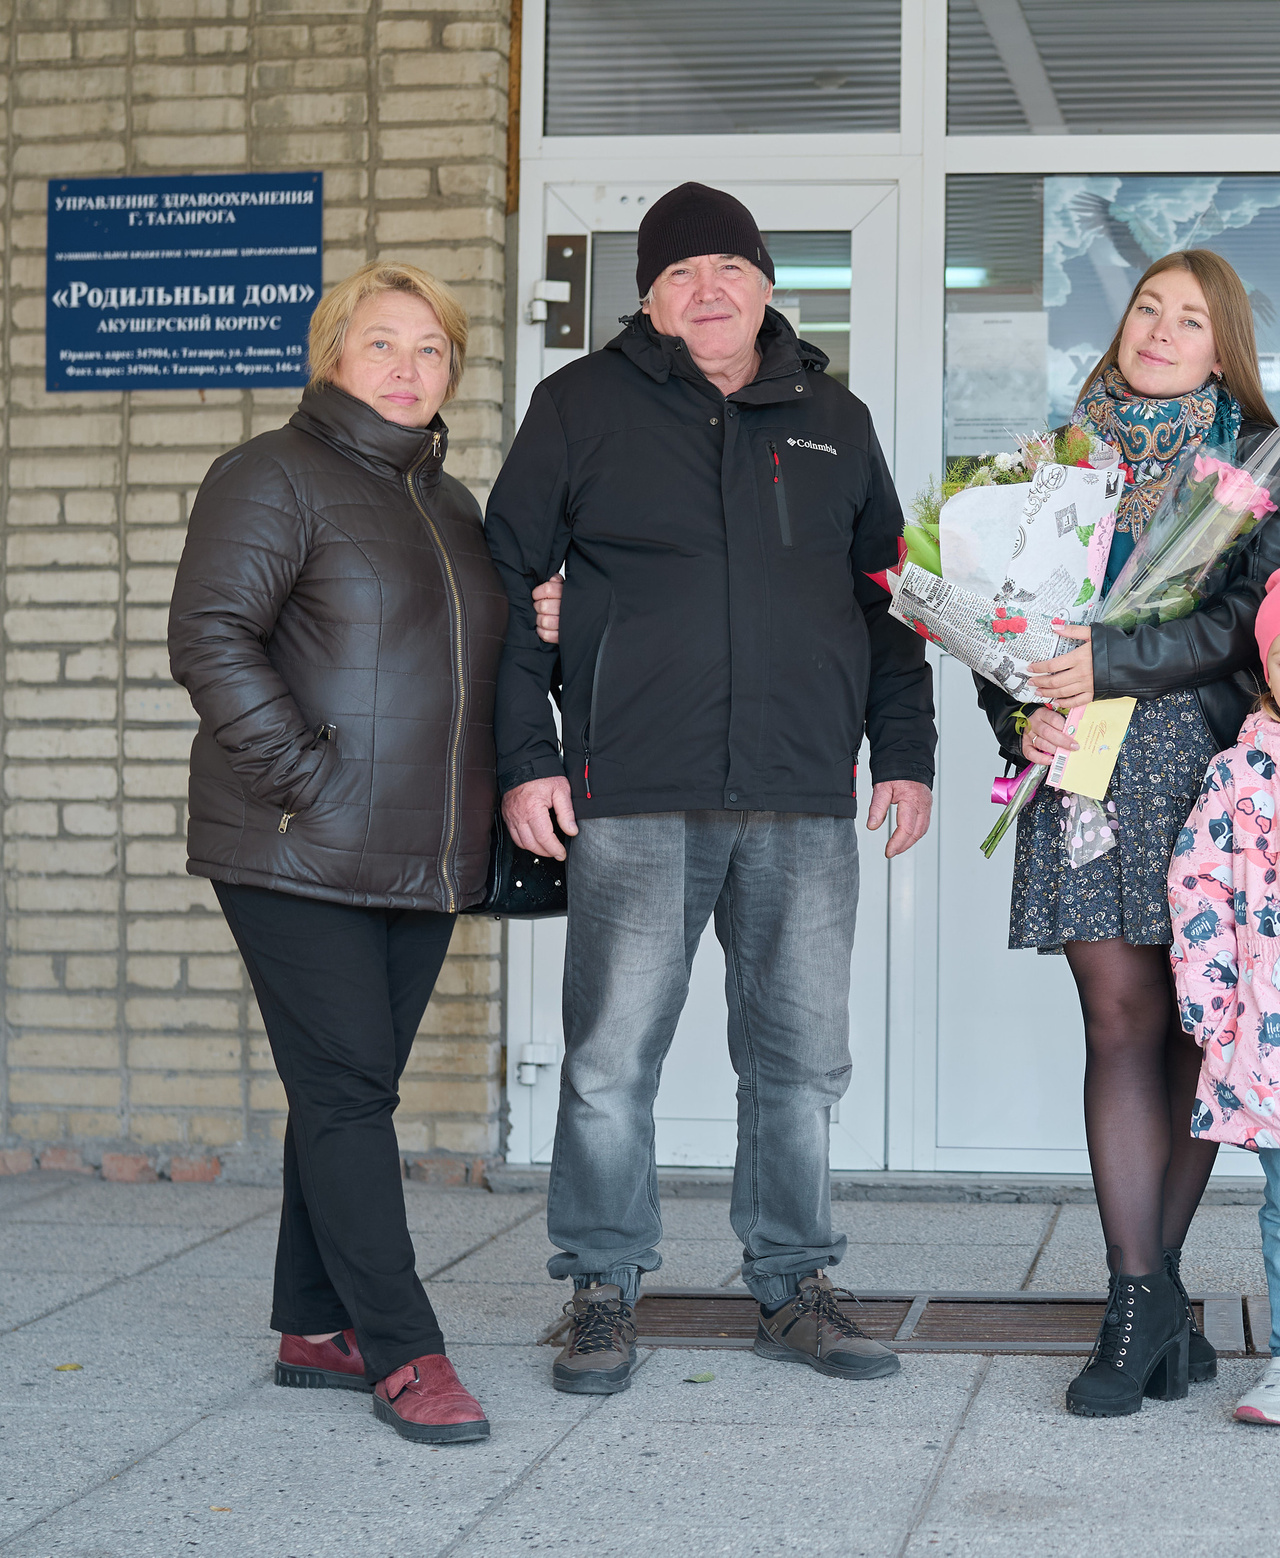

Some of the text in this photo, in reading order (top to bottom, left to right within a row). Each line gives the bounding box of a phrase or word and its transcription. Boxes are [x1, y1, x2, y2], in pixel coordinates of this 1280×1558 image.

[54, 189, 314, 212] УПРАВЛЕНИЕ ЗДРАВООХРАНЕНИЯ
[129, 209, 236, 226] Г. ТАГАНРОГА
[242, 283, 316, 308] дом»
[96, 314, 282, 333] АКУШЕРСКИЙ КОРПУС
[796, 438, 838, 456] Columbia
